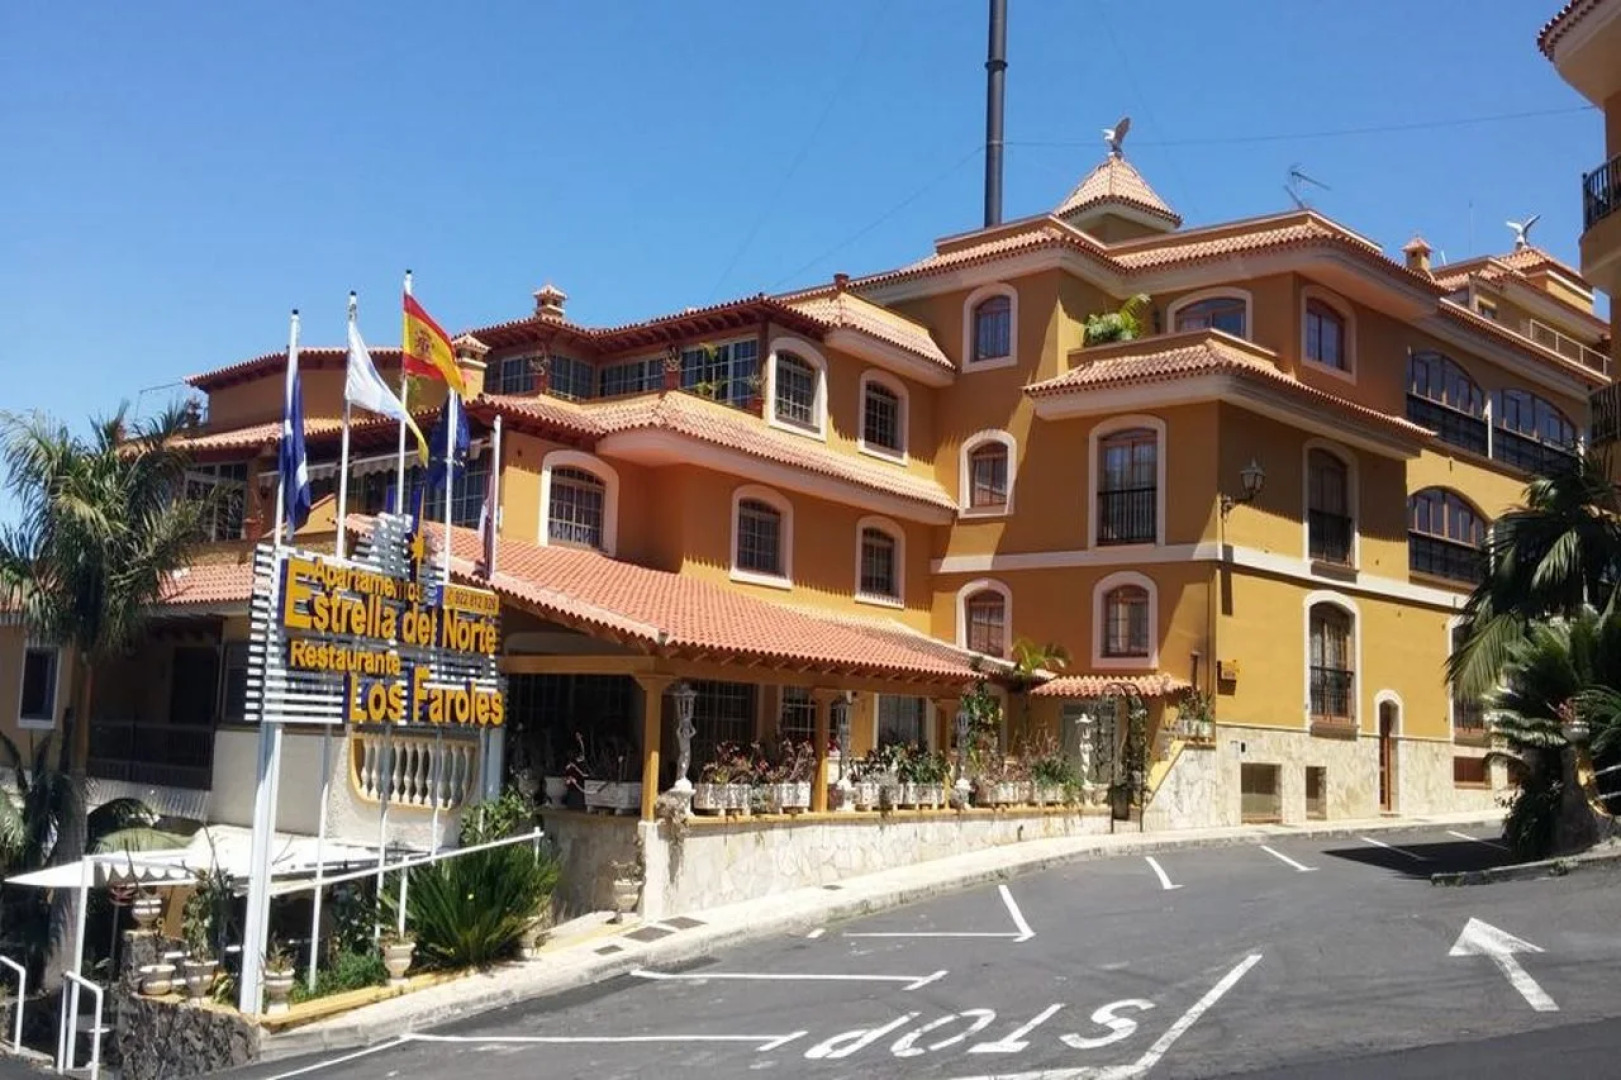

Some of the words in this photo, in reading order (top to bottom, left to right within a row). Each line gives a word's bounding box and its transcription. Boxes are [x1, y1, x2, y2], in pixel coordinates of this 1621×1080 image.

[285, 557, 396, 639] Estrella
[403, 601, 437, 645] del
[442, 608, 497, 653] Norte
[290, 640, 400, 674] Restaurante
[349, 672, 403, 723] Los
[413, 667, 504, 724] Faroles
[804, 998, 1157, 1058] STOP
